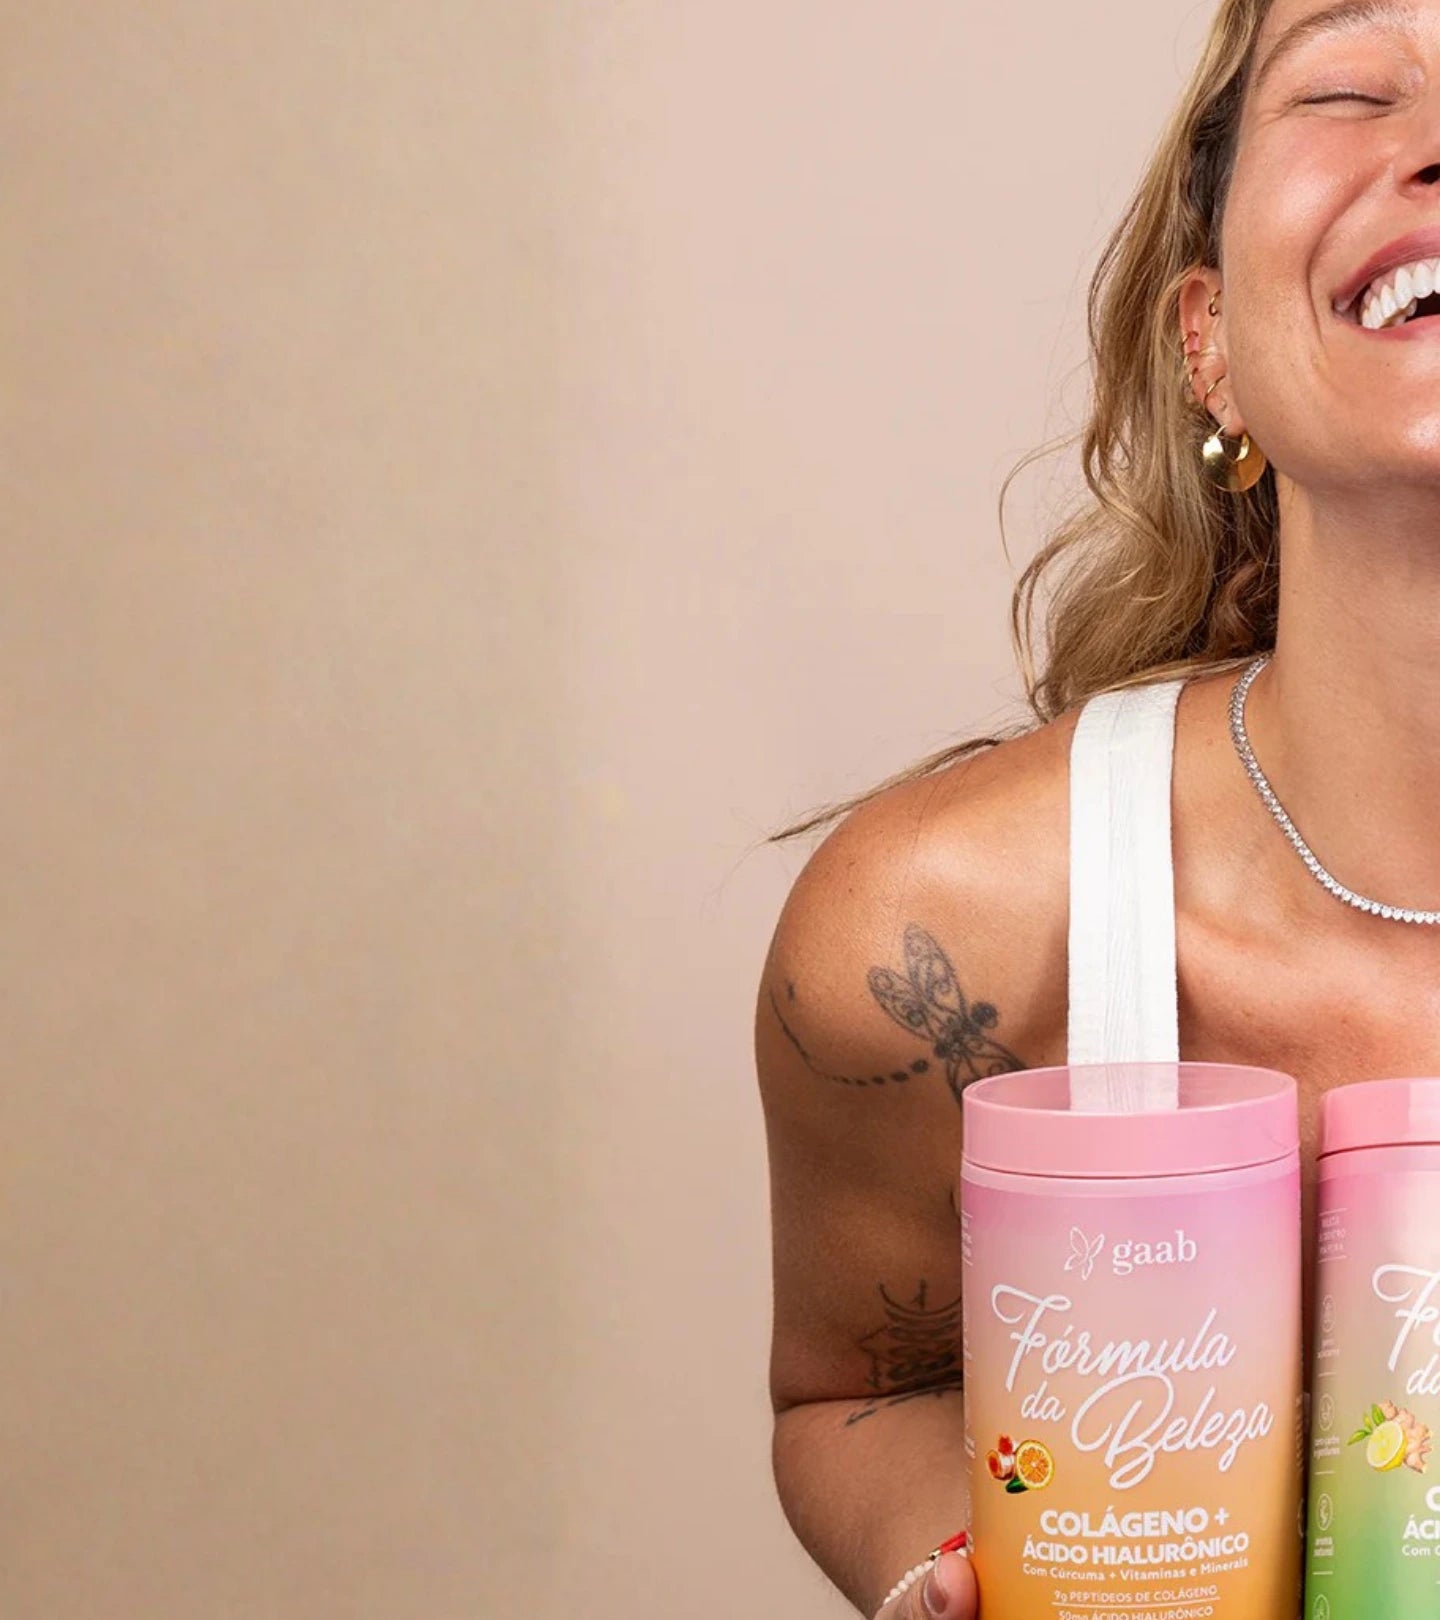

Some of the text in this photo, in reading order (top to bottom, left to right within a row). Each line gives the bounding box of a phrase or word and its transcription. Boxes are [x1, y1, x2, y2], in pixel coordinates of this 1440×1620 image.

[1112, 1229, 1197, 1275] gaab
[991, 1284, 1237, 1392] Fórmula
[1021, 1381, 1066, 1421] da
[1070, 1371, 1275, 1489] Beleza
[1040, 1506, 1230, 1538] COLÁGENO +
[1022, 1532, 1249, 1566] ÁCIDO HIALURÔNICO
[1401, 1545, 1431, 1557] Com
[1022, 1562, 1048, 1577] Com
[1049, 1566, 1106, 1581] Cúrcuma
[1120, 1568, 1187, 1581] Vitaminas
[1189, 1568, 1197, 1577] e
[1200, 1559, 1249, 1575] Minerais
[1136, 1591, 1151, 1602] DE
[1153, 1585, 1218, 1601] COLÁGENO
